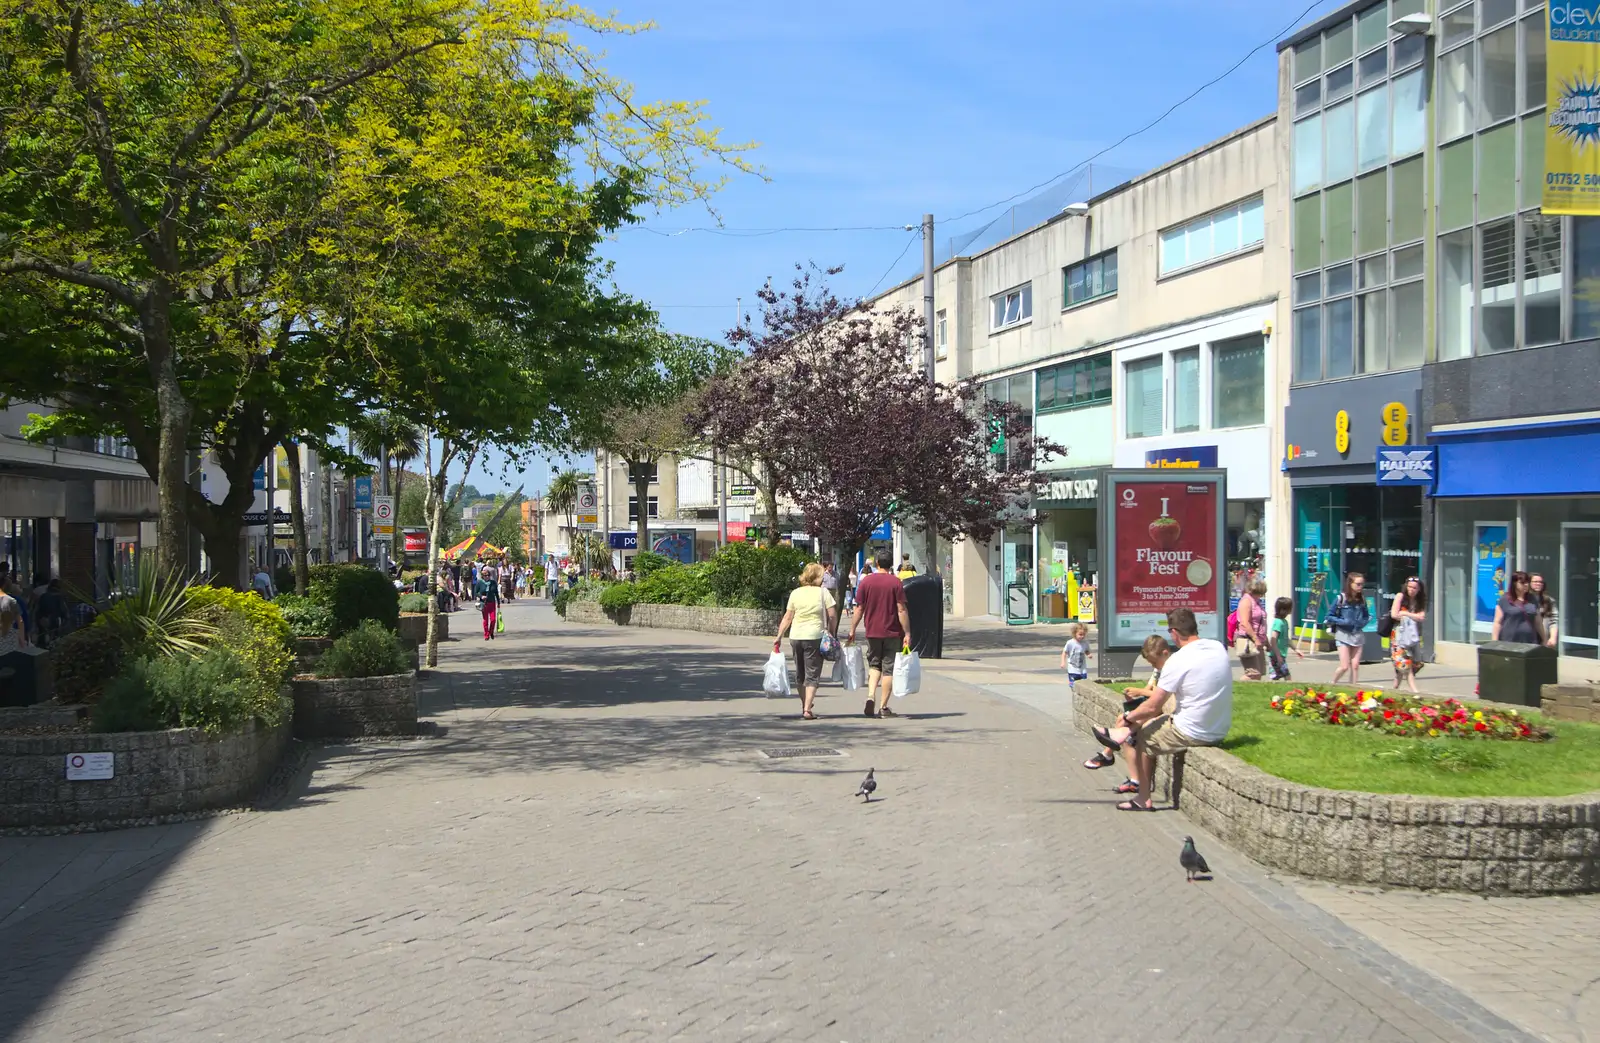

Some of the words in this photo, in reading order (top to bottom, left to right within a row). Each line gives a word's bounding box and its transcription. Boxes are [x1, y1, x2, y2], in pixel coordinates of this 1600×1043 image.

[1546, 172, 1581, 185] 01752
[1380, 460, 1433, 471] HALIFAX
[1052, 480, 1074, 500] BODY
[1160, 498, 1169, 516] I
[1136, 548, 1193, 562] Flavour
[1149, 562, 1180, 575] Fest
[1174, 592, 1189, 600] 2016
